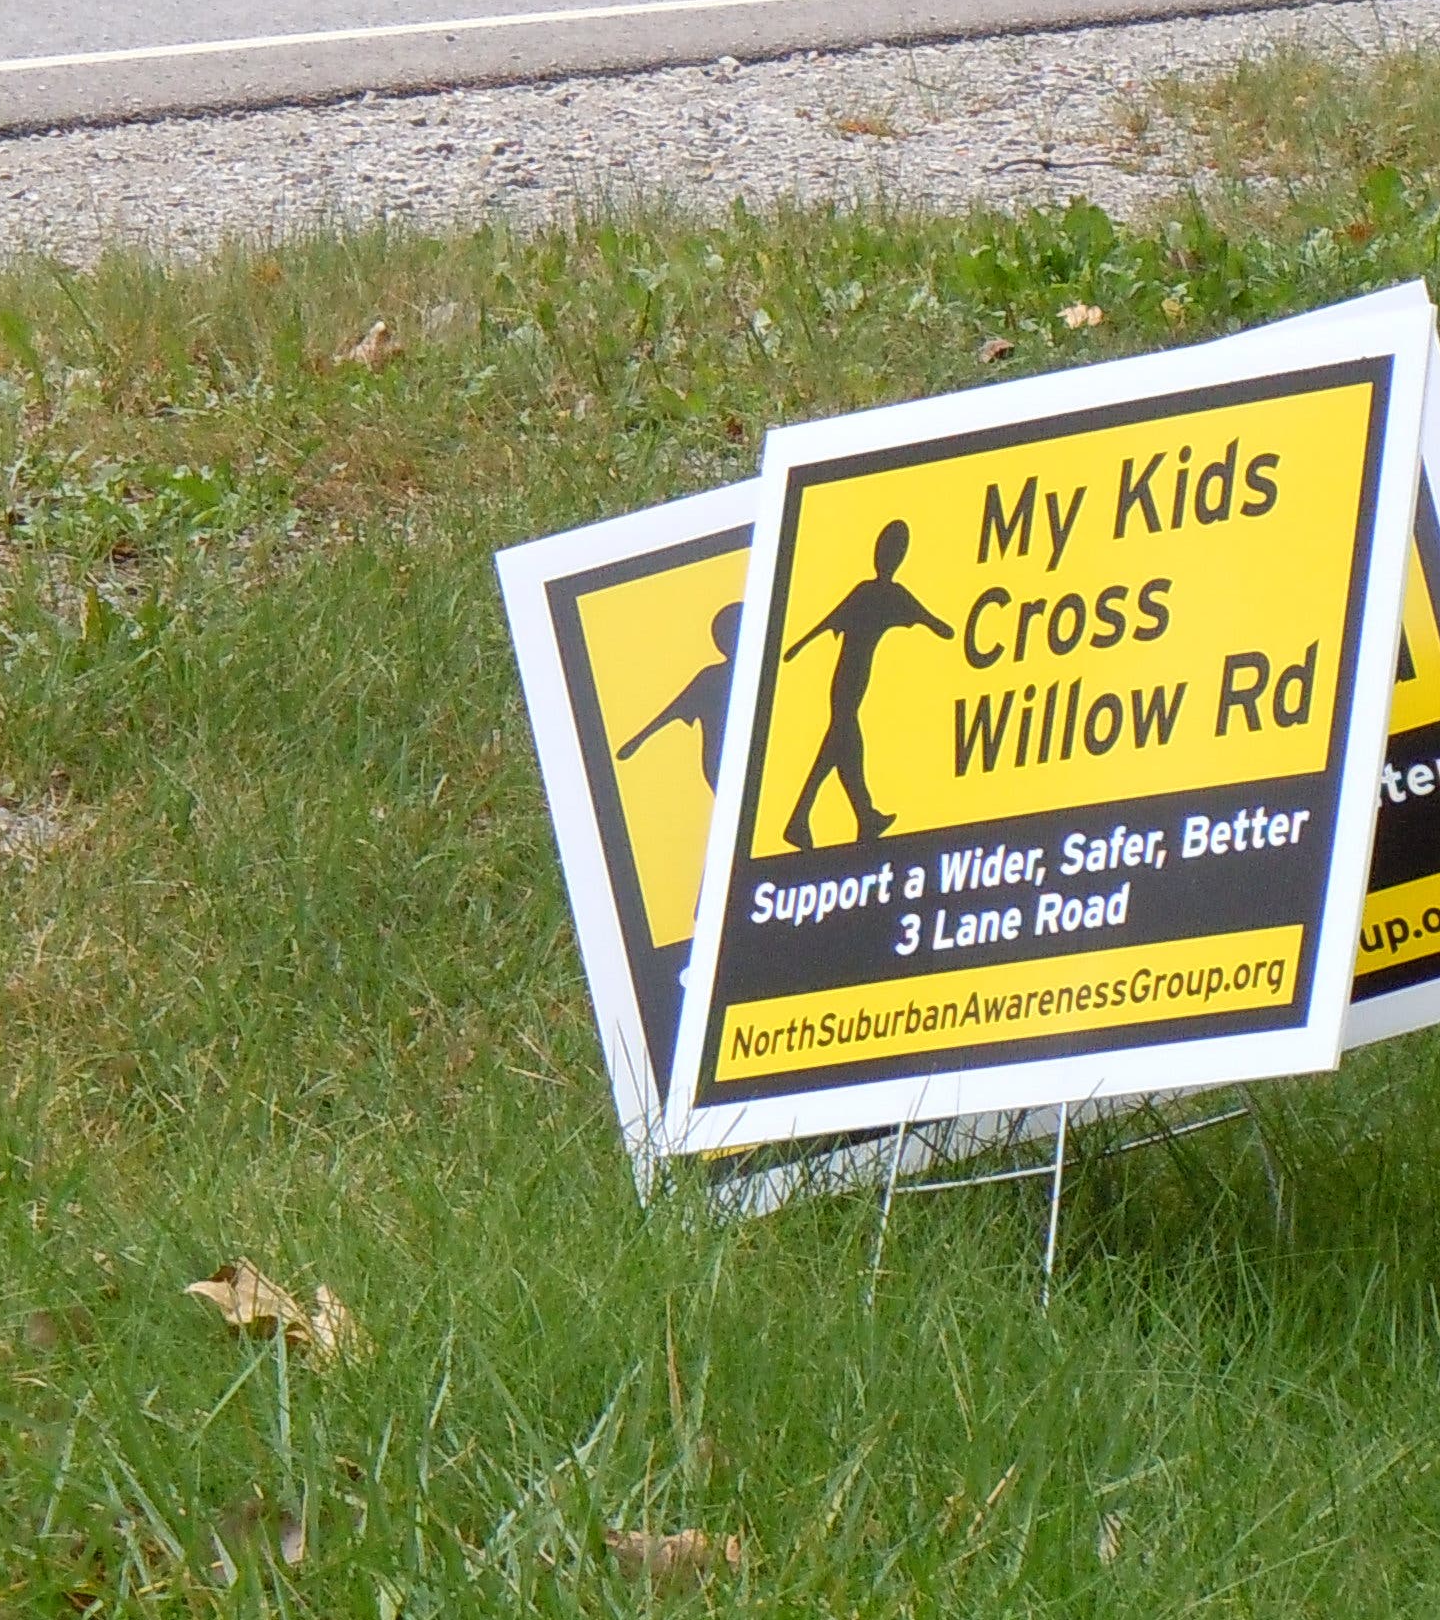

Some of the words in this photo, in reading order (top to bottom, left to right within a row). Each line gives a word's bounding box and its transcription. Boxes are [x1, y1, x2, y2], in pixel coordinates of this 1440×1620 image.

[976, 475, 1088, 573] My
[1112, 436, 1281, 540] Kids
[963, 578, 1173, 670] Cross
[954, 676, 1189, 778] Willow
[1214, 638, 1320, 738] Rd
[750, 862, 894, 927] Support
[903, 865, 926, 900] a
[939, 843, 1047, 894] Wider,
[1060, 825, 1167, 876] Safer,
[1181, 805, 1311, 859] Better
[894, 912, 922, 956] 3
[931, 905, 1023, 951] Lane
[1033, 880, 1131, 936] Road
[730, 958, 1286, 1061] NorthSuburbanAwarenessGroup.org
